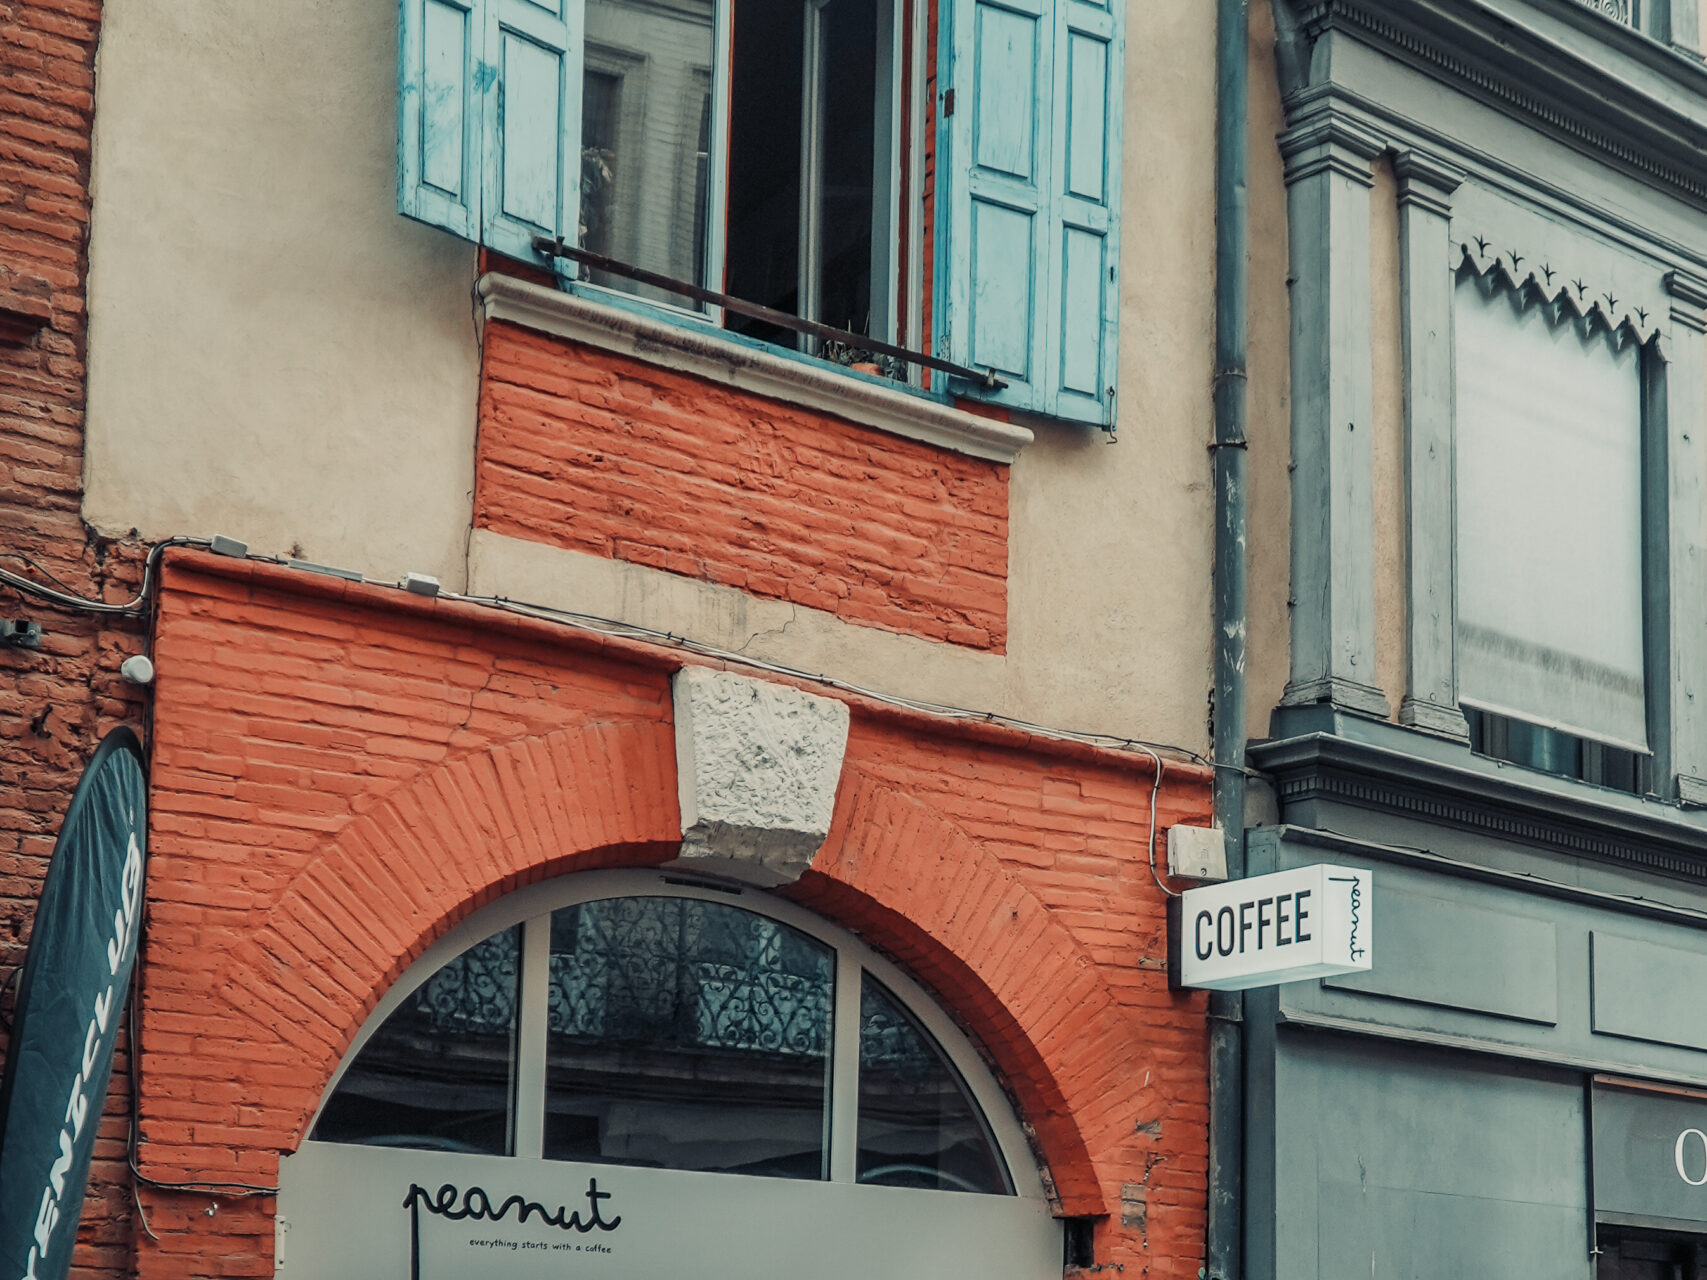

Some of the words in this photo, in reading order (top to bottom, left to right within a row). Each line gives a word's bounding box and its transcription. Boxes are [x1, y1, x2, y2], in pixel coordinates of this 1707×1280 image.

[1195, 889, 1312, 961] COFFEE
[1328, 875, 1365, 962] peanut
[469, 1239, 518, 1251] everything
[521, 1240, 548, 1250] starts
[552, 1242, 572, 1252] with
[575, 1244, 581, 1252] a
[585, 1243, 612, 1254] coffee
